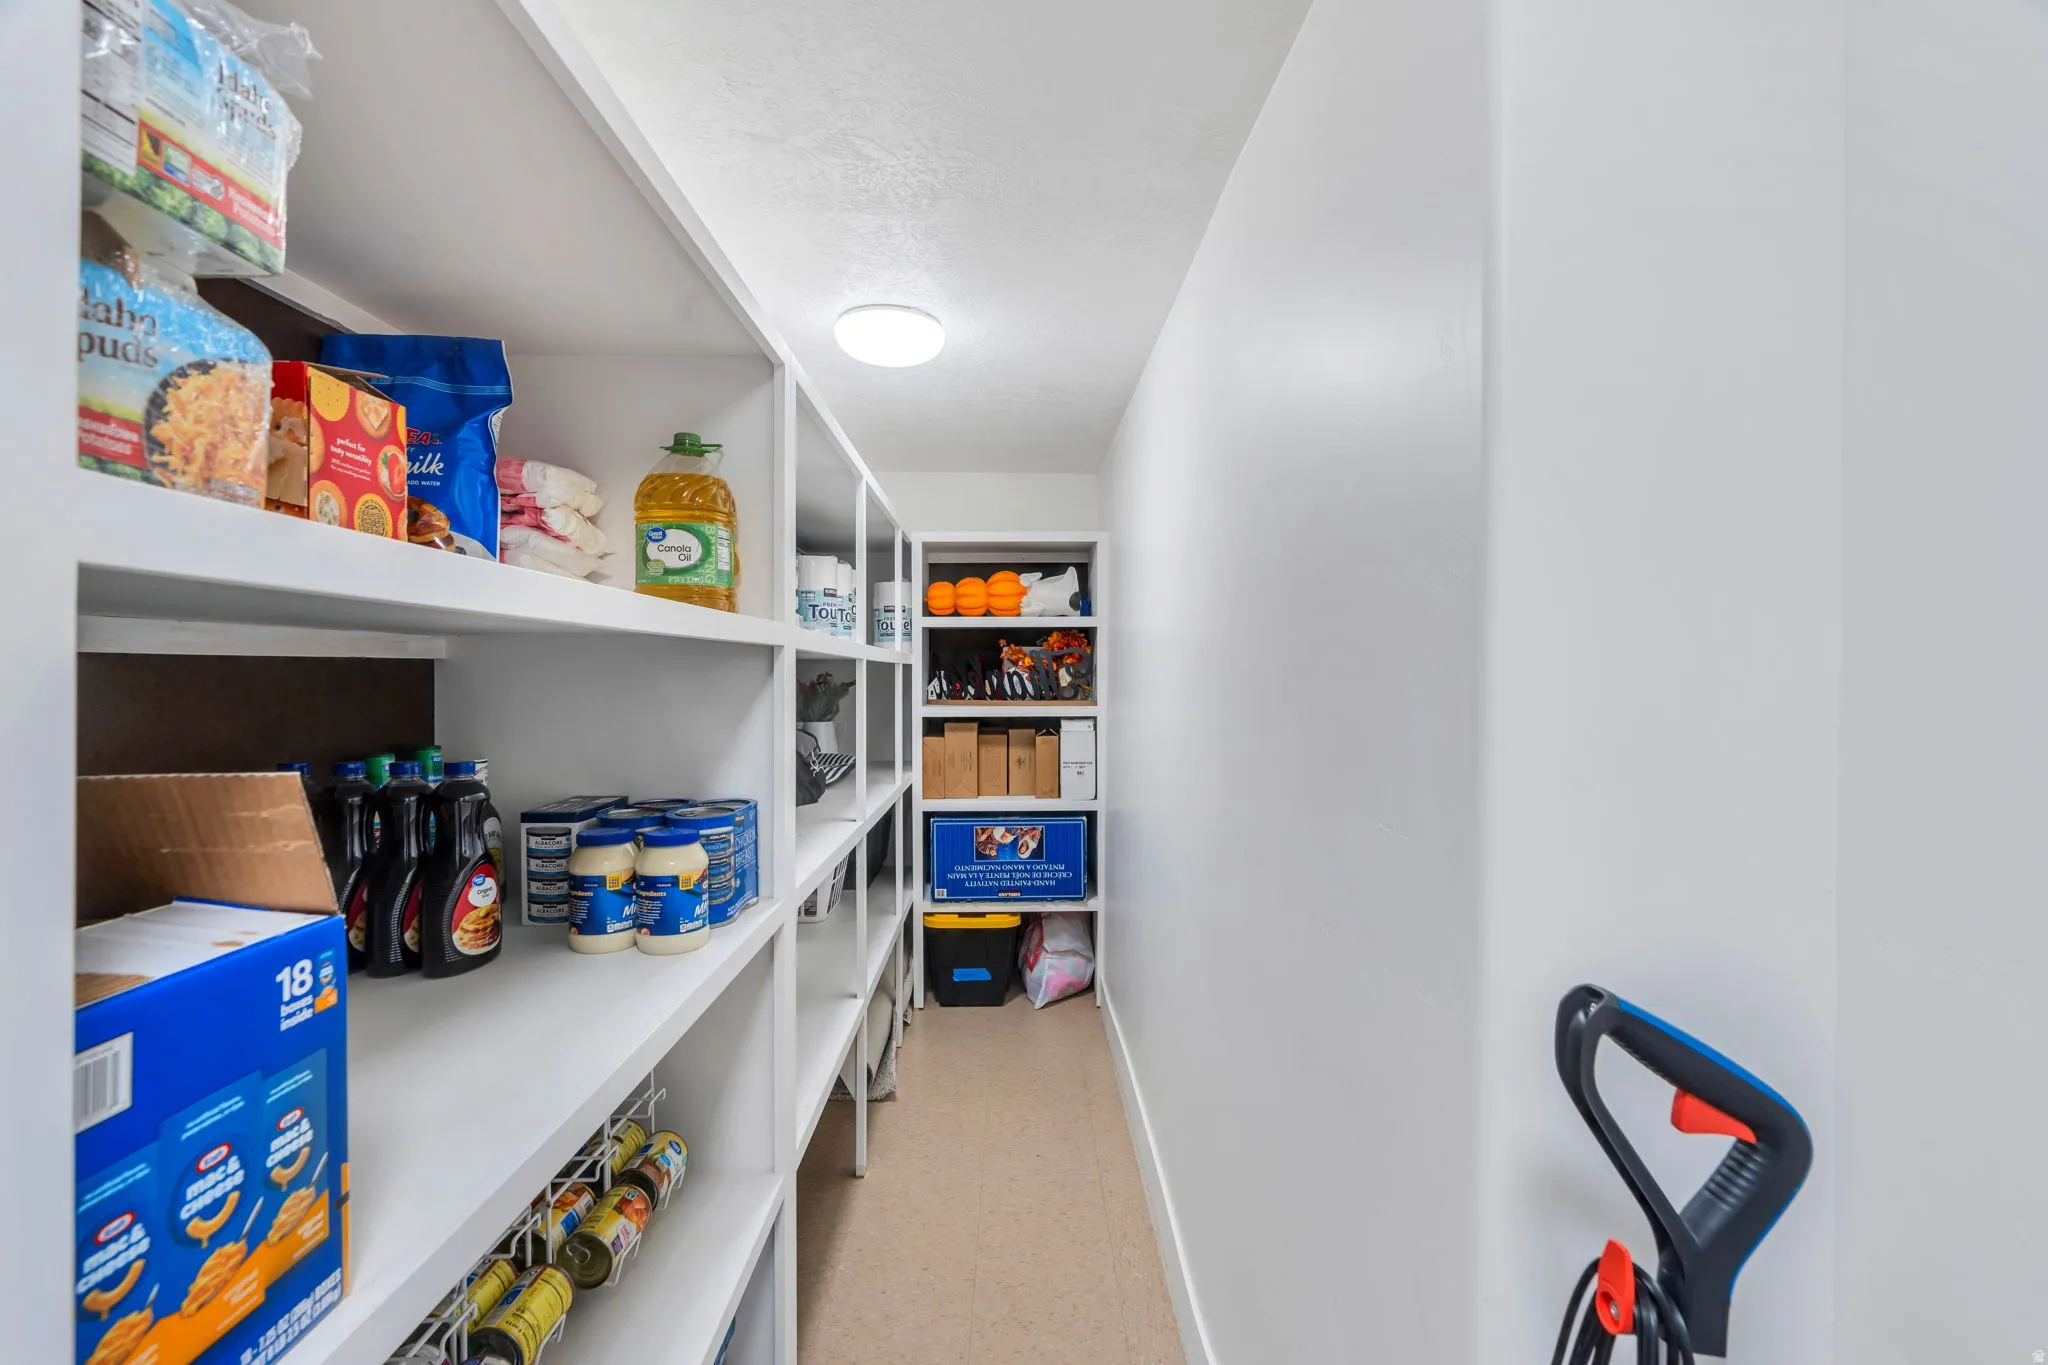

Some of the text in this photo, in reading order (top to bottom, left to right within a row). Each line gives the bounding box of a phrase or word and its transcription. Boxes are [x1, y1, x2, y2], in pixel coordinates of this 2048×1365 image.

[79, 330, 159, 368] puds
[657, 543, 692, 553] Canola
[678, 553, 692, 562] Oil
[275, 959, 314, 1003] 18
[280, 1007, 314, 1032] inside
[314, 1268, 342, 1303] BOXES
